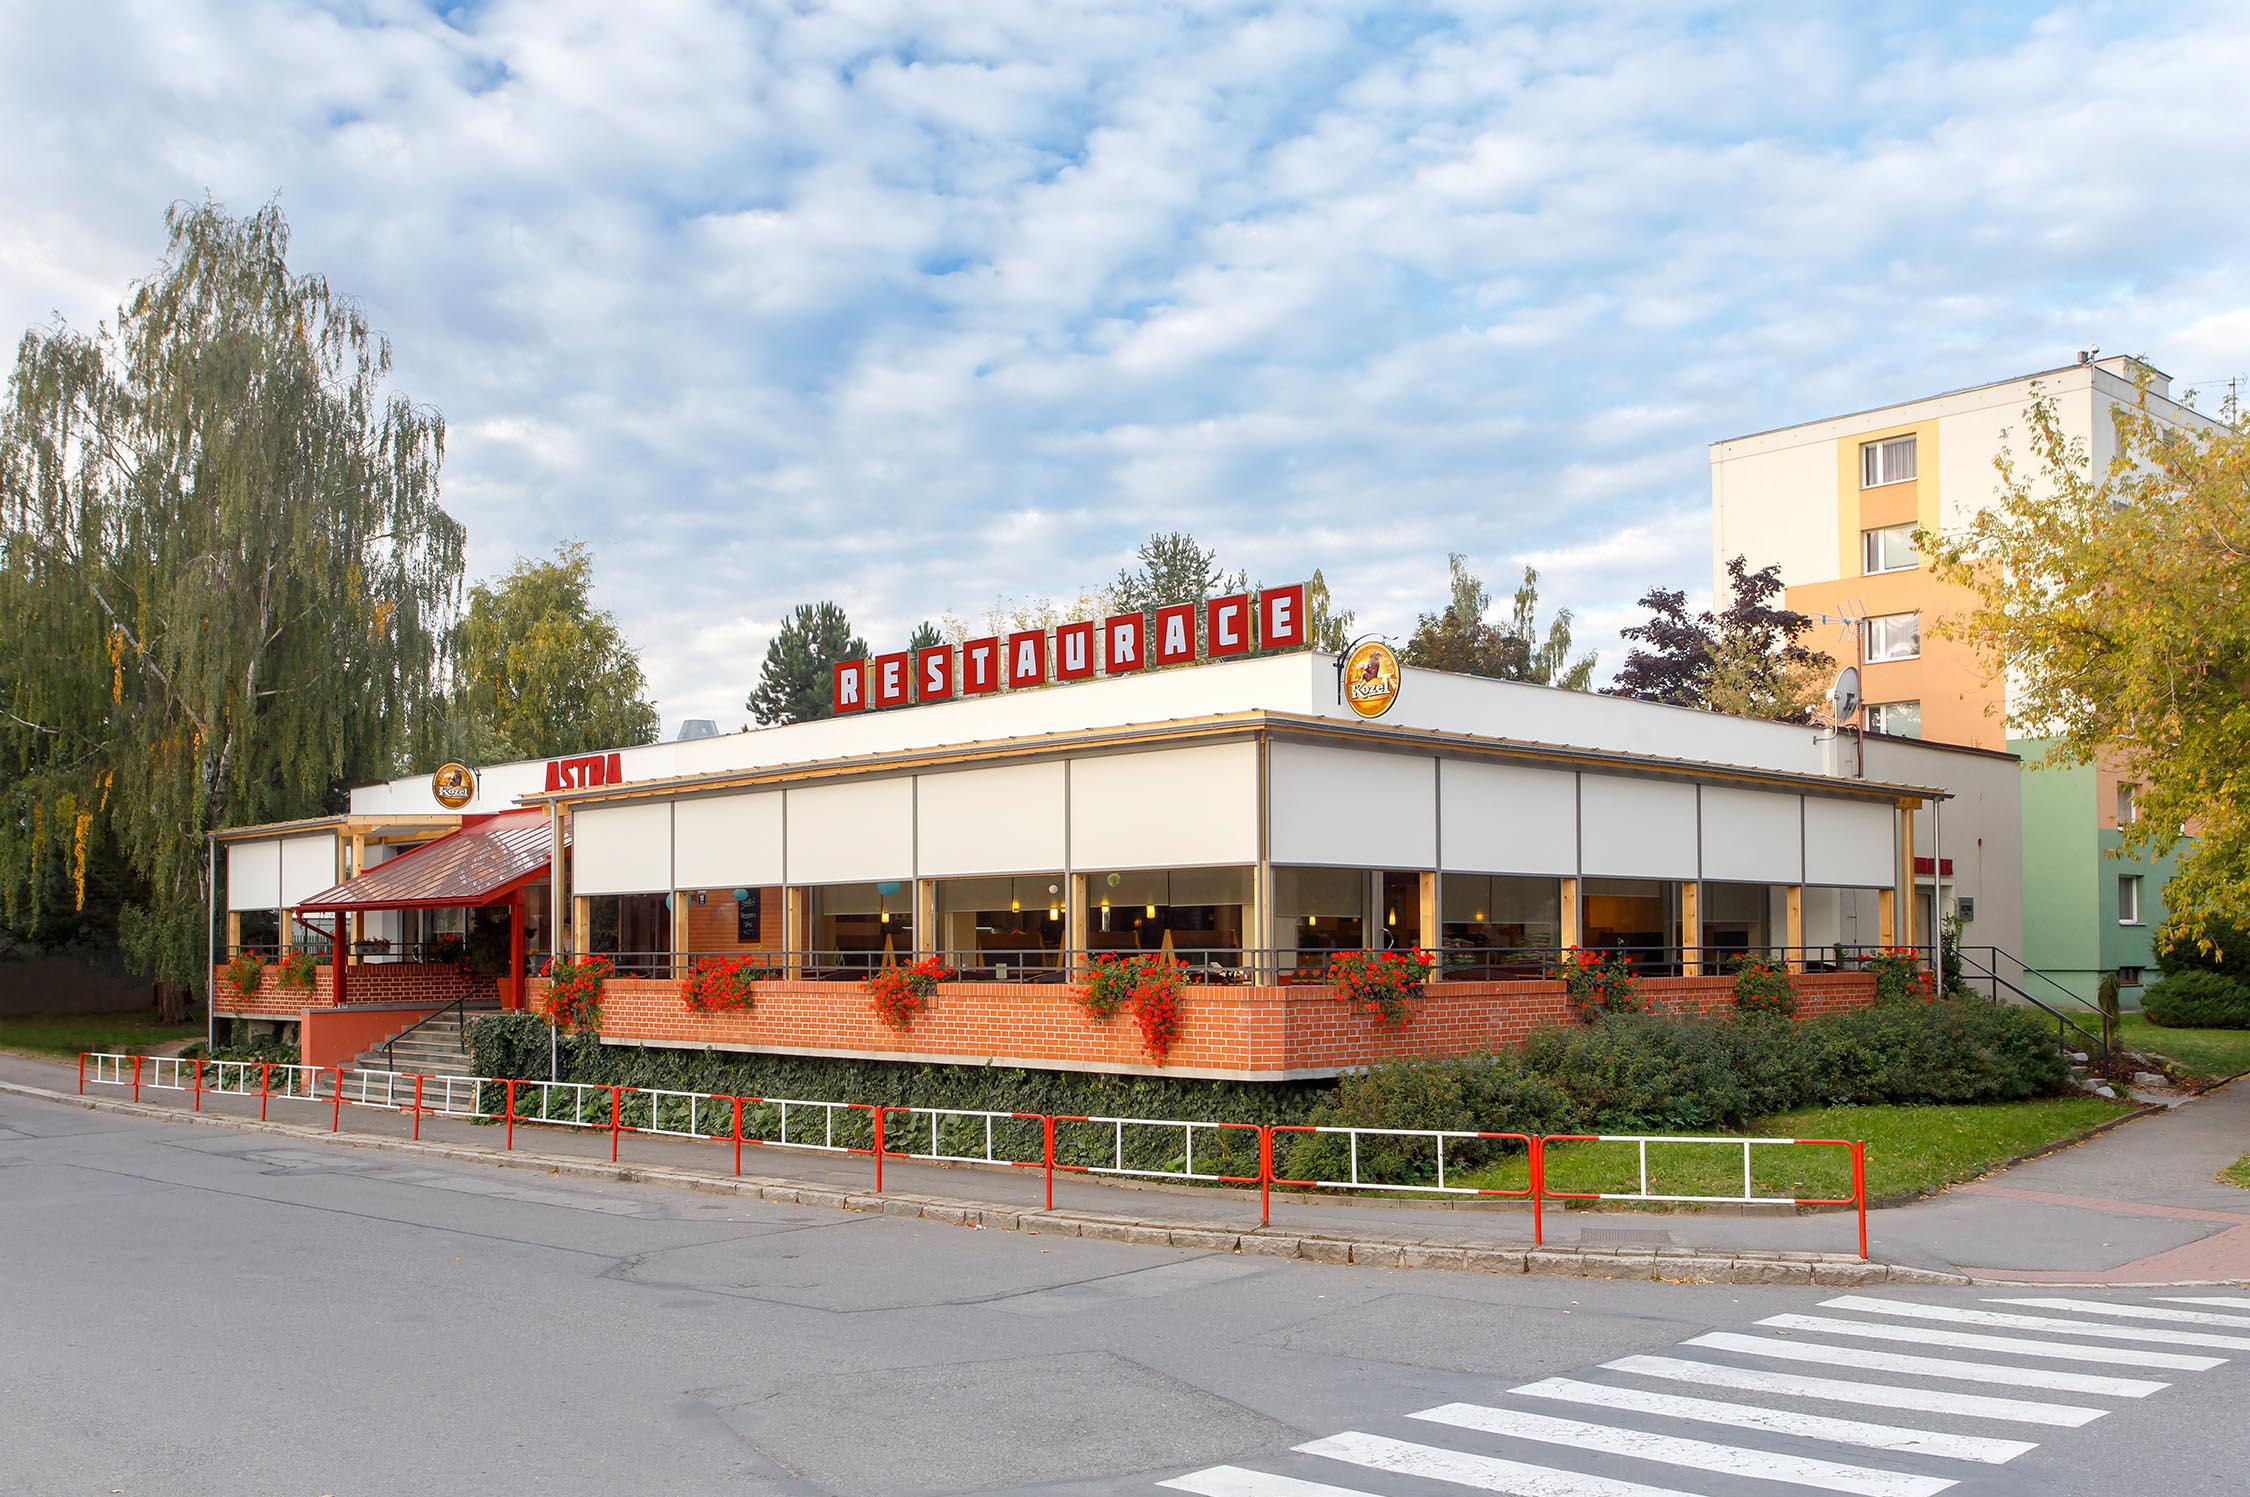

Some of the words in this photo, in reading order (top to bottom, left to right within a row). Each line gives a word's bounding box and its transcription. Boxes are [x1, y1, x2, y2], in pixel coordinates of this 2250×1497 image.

[841, 596, 1292, 705] RESTAURACE
[1351, 677, 1392, 699] Kozel
[545, 753, 622, 792] ASTRA
[439, 786, 469, 797] Kozel
